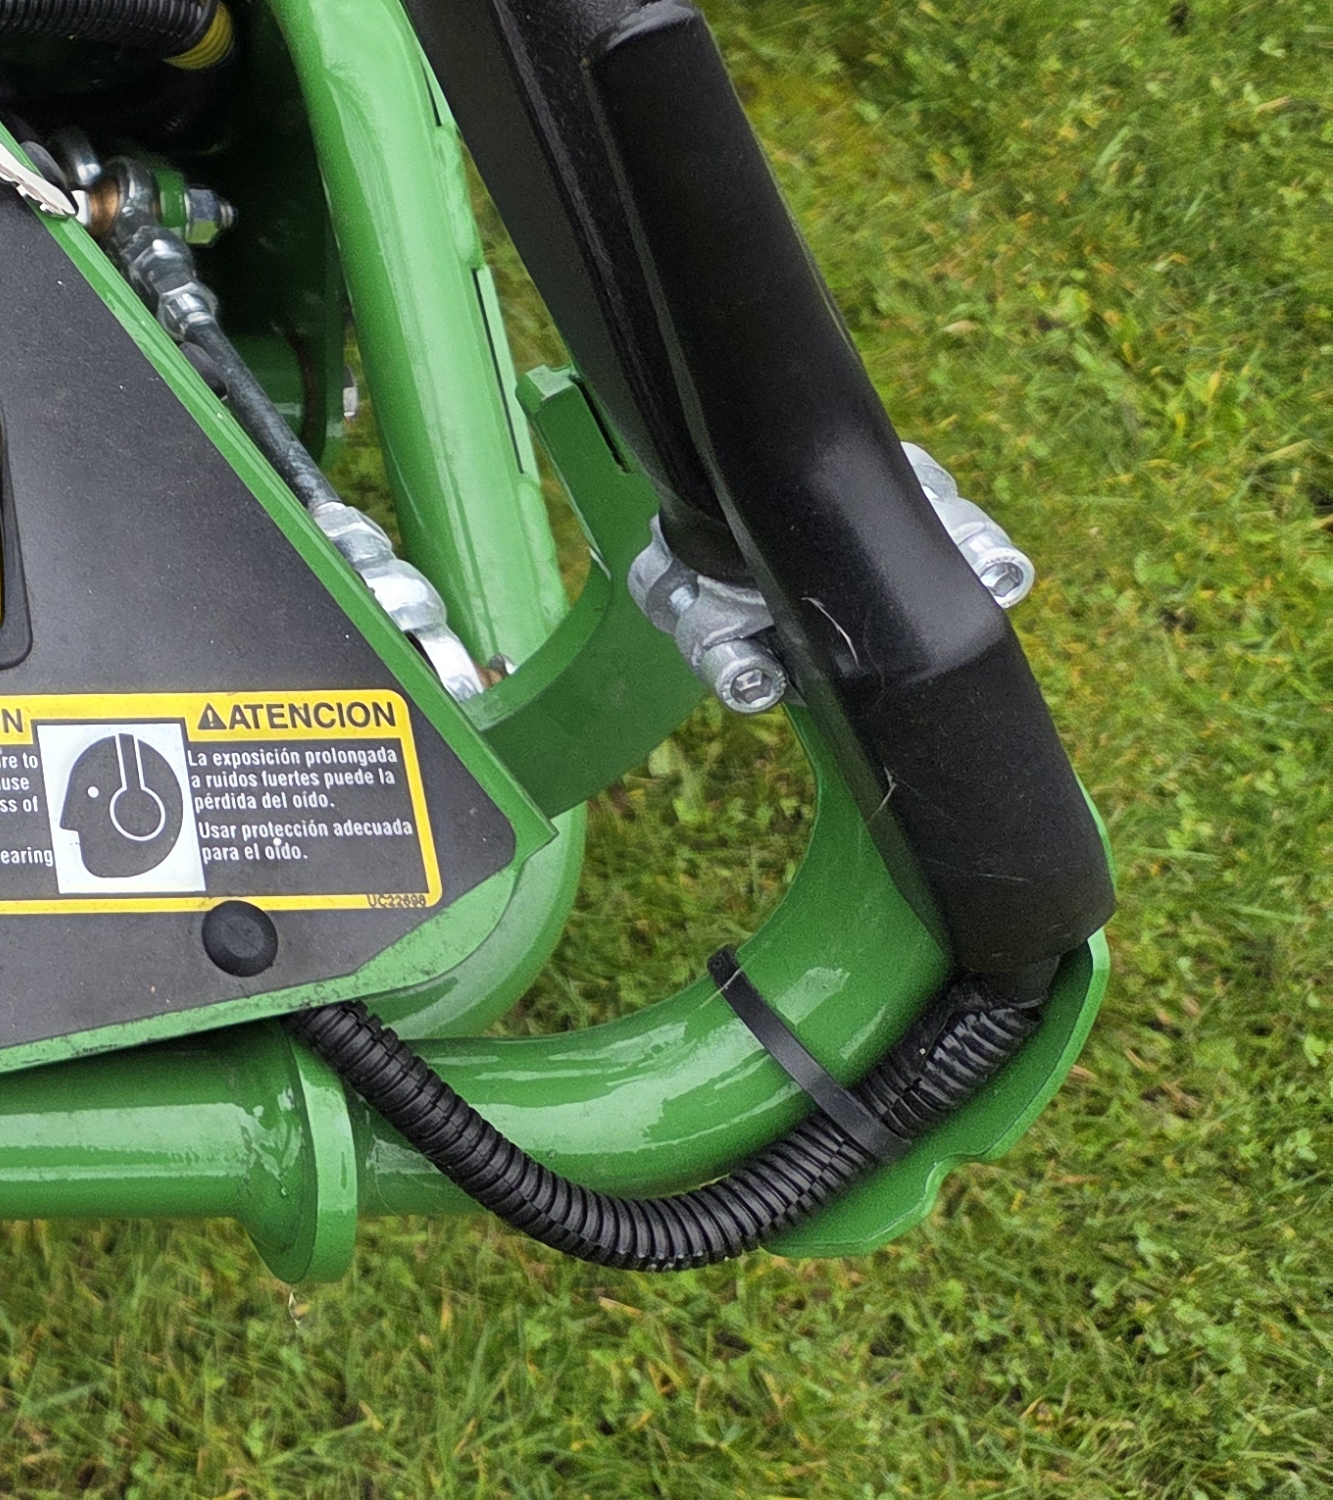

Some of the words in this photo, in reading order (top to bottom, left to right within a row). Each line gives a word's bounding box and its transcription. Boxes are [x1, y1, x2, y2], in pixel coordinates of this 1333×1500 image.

[229, 702, 396, 730] ATENCION
[21, 751, 39, 769] to
[186, 749, 208, 767] La
[304, 745, 398, 768] prolongada
[190, 774, 201, 789] a
[205, 770, 258, 788] ruidos
[261, 769, 320, 787] fuertes
[323, 767, 374, 790] puede
[378, 767, 395, 784] la
[22, 794, 38, 813] of
[194, 791, 257, 814] pérdida
[261, 791, 288, 809] del
[197, 821, 237, 839] Usar
[332, 817, 413, 837] adecuada
